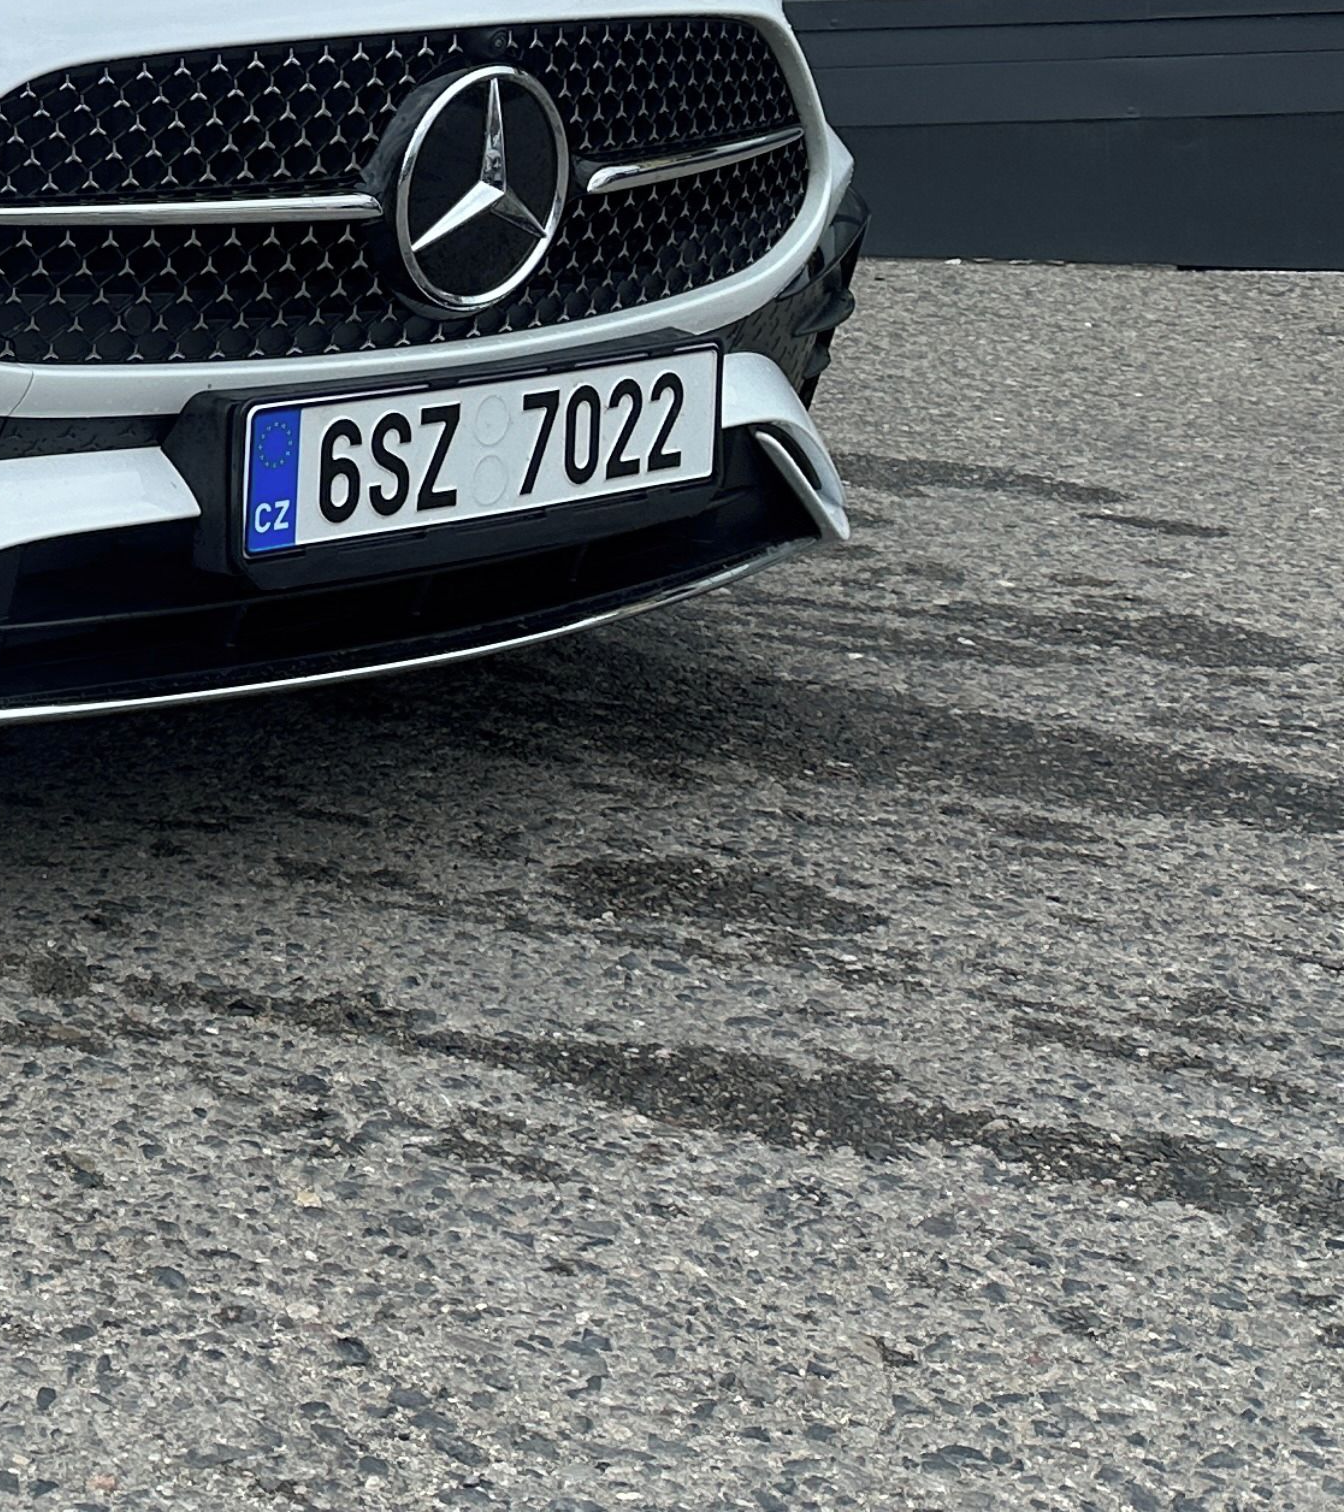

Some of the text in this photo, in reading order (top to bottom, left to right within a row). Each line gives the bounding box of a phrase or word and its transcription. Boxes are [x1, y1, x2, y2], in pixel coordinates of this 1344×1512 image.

[317, 371, 685, 524] 6SZ 7022
[254, 499, 290, 534] CZ
